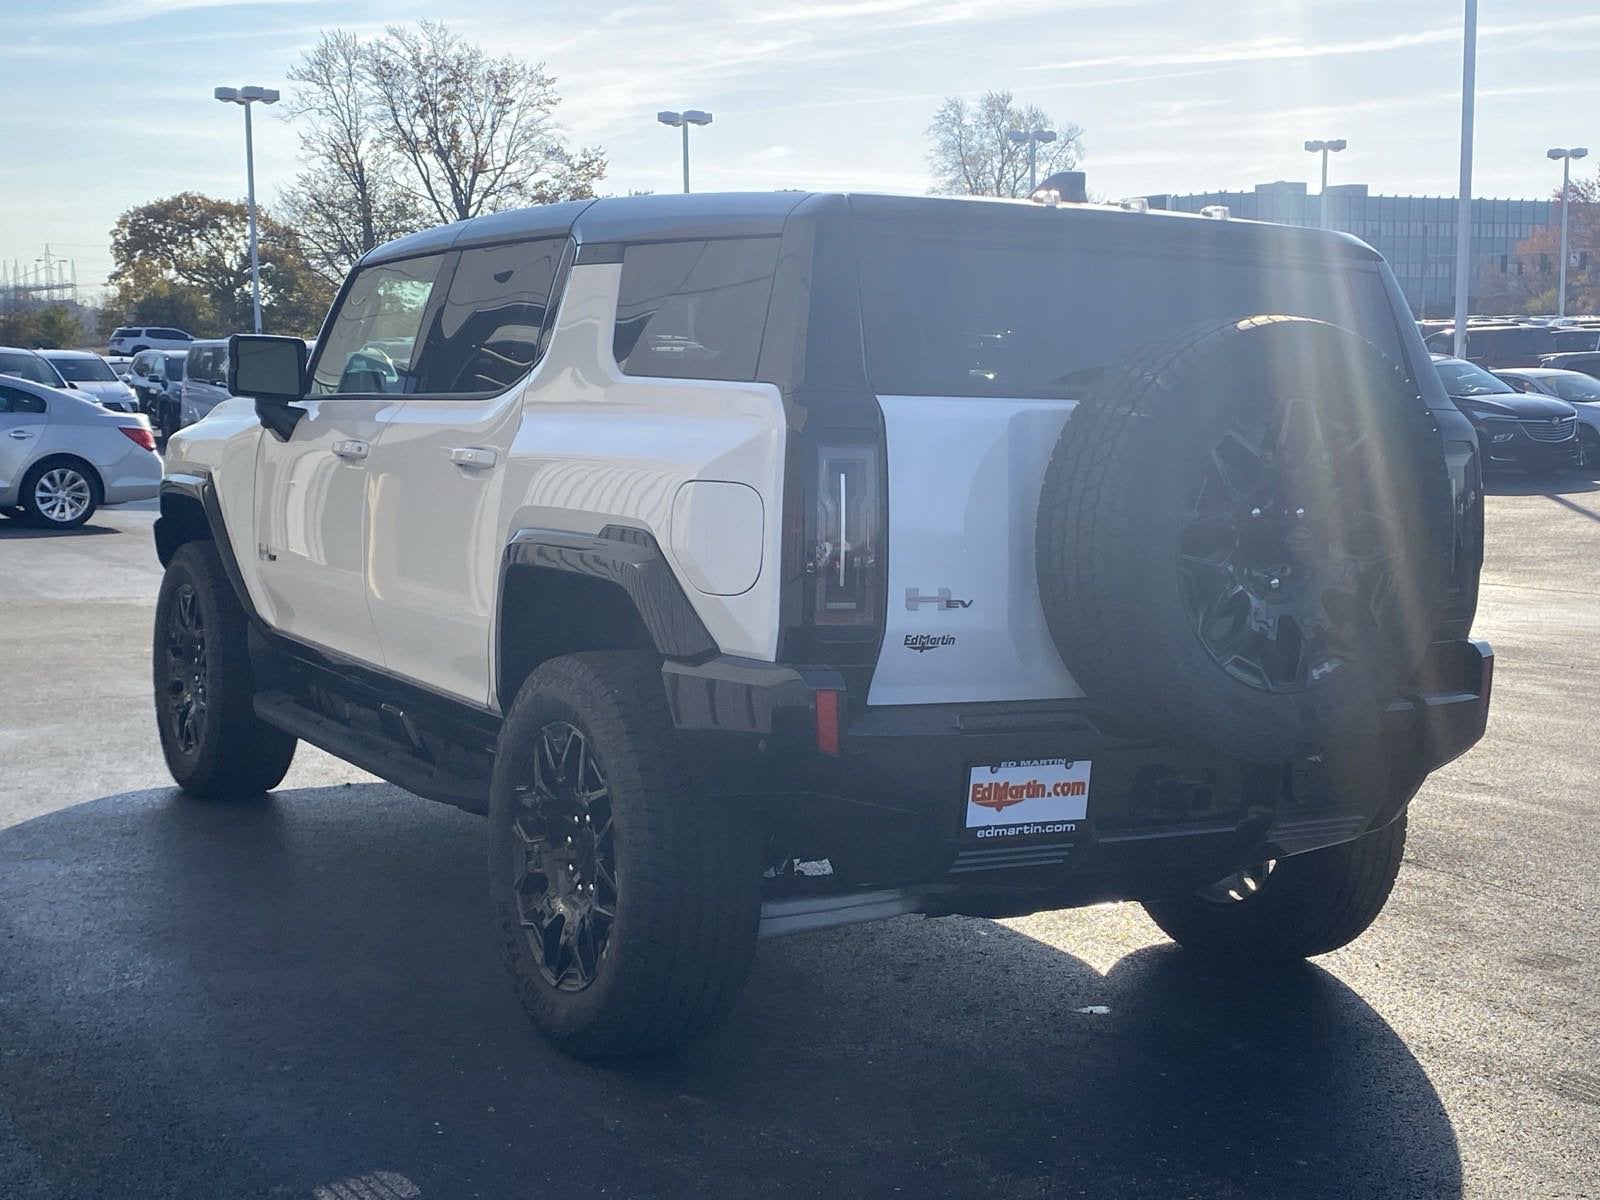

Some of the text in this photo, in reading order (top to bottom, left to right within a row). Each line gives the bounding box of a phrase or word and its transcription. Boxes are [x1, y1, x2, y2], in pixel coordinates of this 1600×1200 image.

[904, 634, 956, 648] EdMartin
[1001, 758, 1067, 768] ED MARTIN
[971, 780, 1086, 803] EdMartin.com
[976, 823, 1076, 838] edmartin.com
